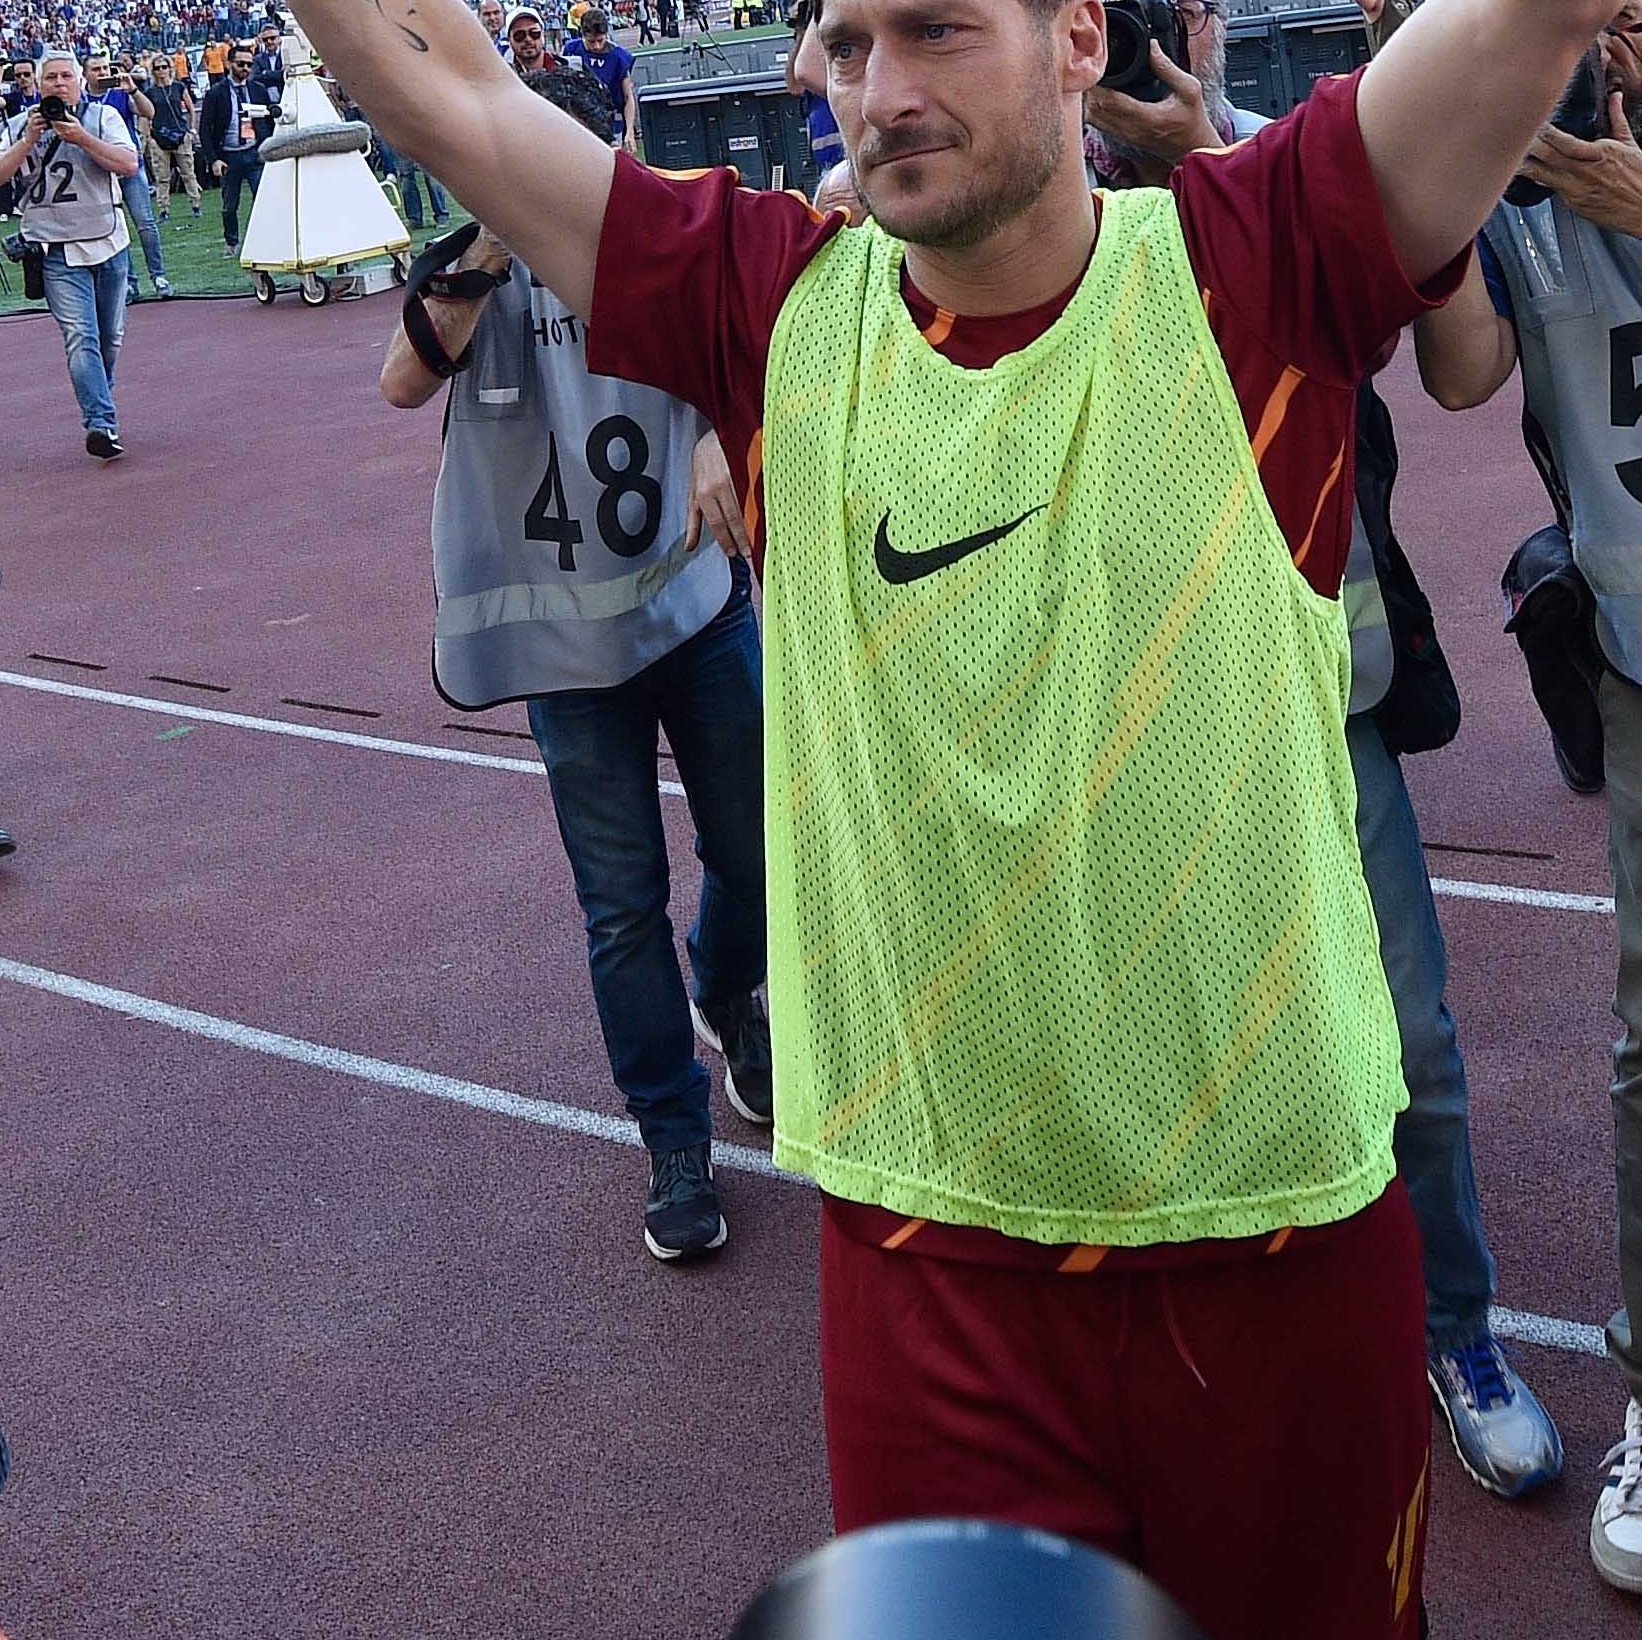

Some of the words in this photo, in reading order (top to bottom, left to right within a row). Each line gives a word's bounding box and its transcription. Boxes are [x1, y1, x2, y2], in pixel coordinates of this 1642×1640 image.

[590, 58, 605, 68] TV
[532, 315, 587, 347] HOT
[524, 414, 662, 572] 48
